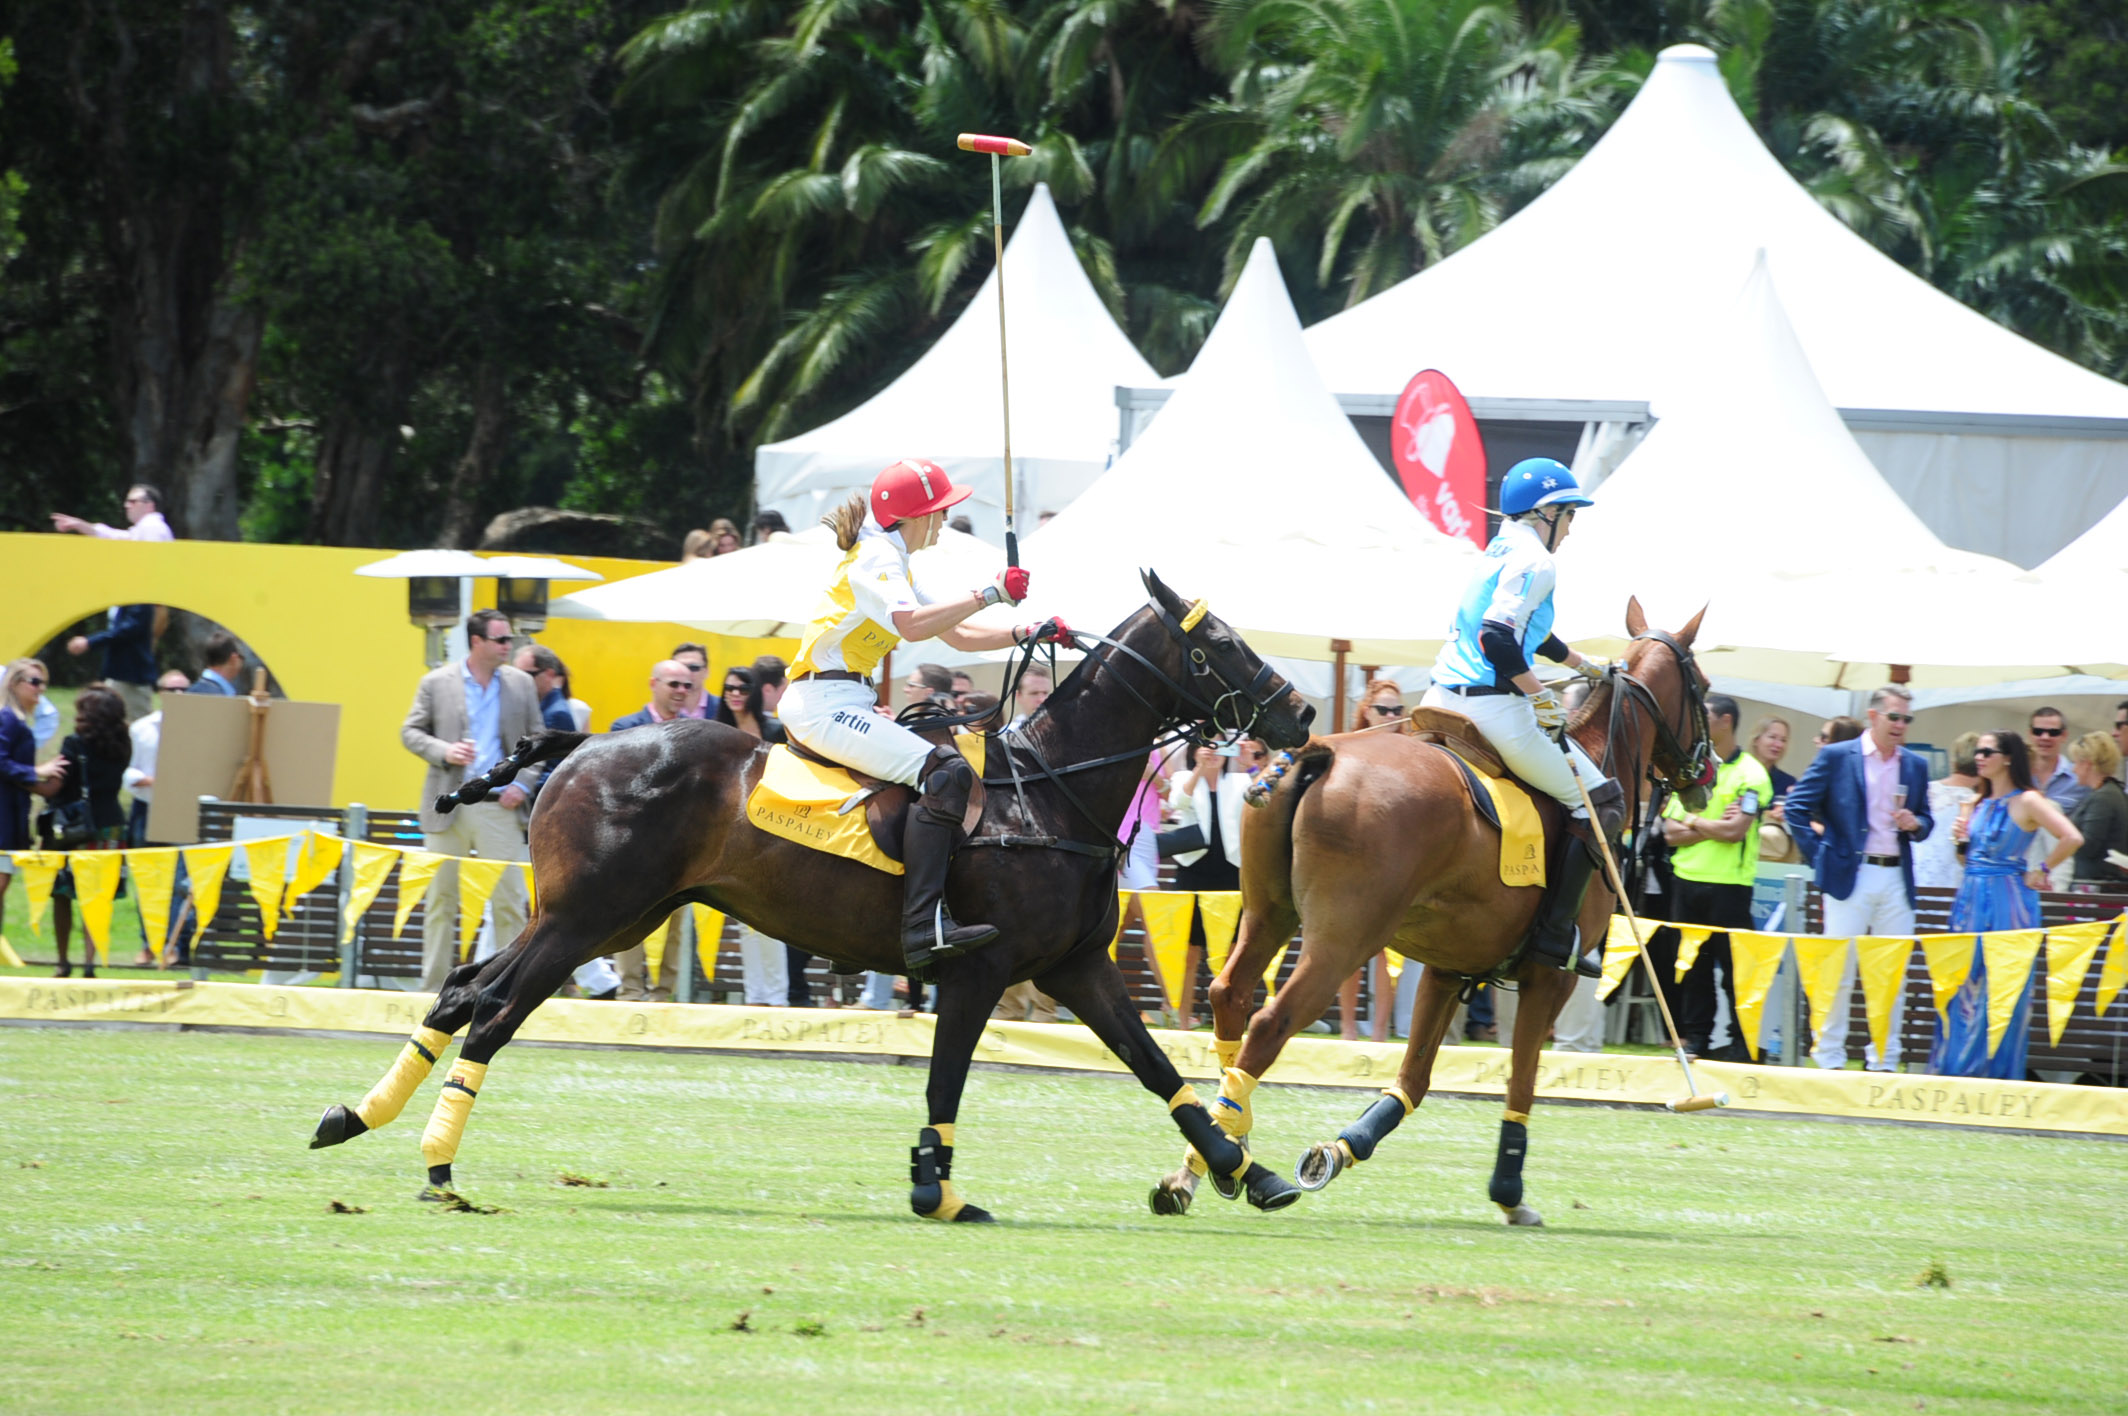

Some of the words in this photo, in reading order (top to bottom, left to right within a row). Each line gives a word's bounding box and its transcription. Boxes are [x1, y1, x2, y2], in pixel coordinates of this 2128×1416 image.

[831, 711, 870, 735] artin
[756, 806, 836, 841] PASPALEY
[743, 1018, 892, 1044] PASPALEY
[1473, 1061, 1633, 1091] PAPALEY
[1867, 1084, 2040, 1118] PASPALEY
